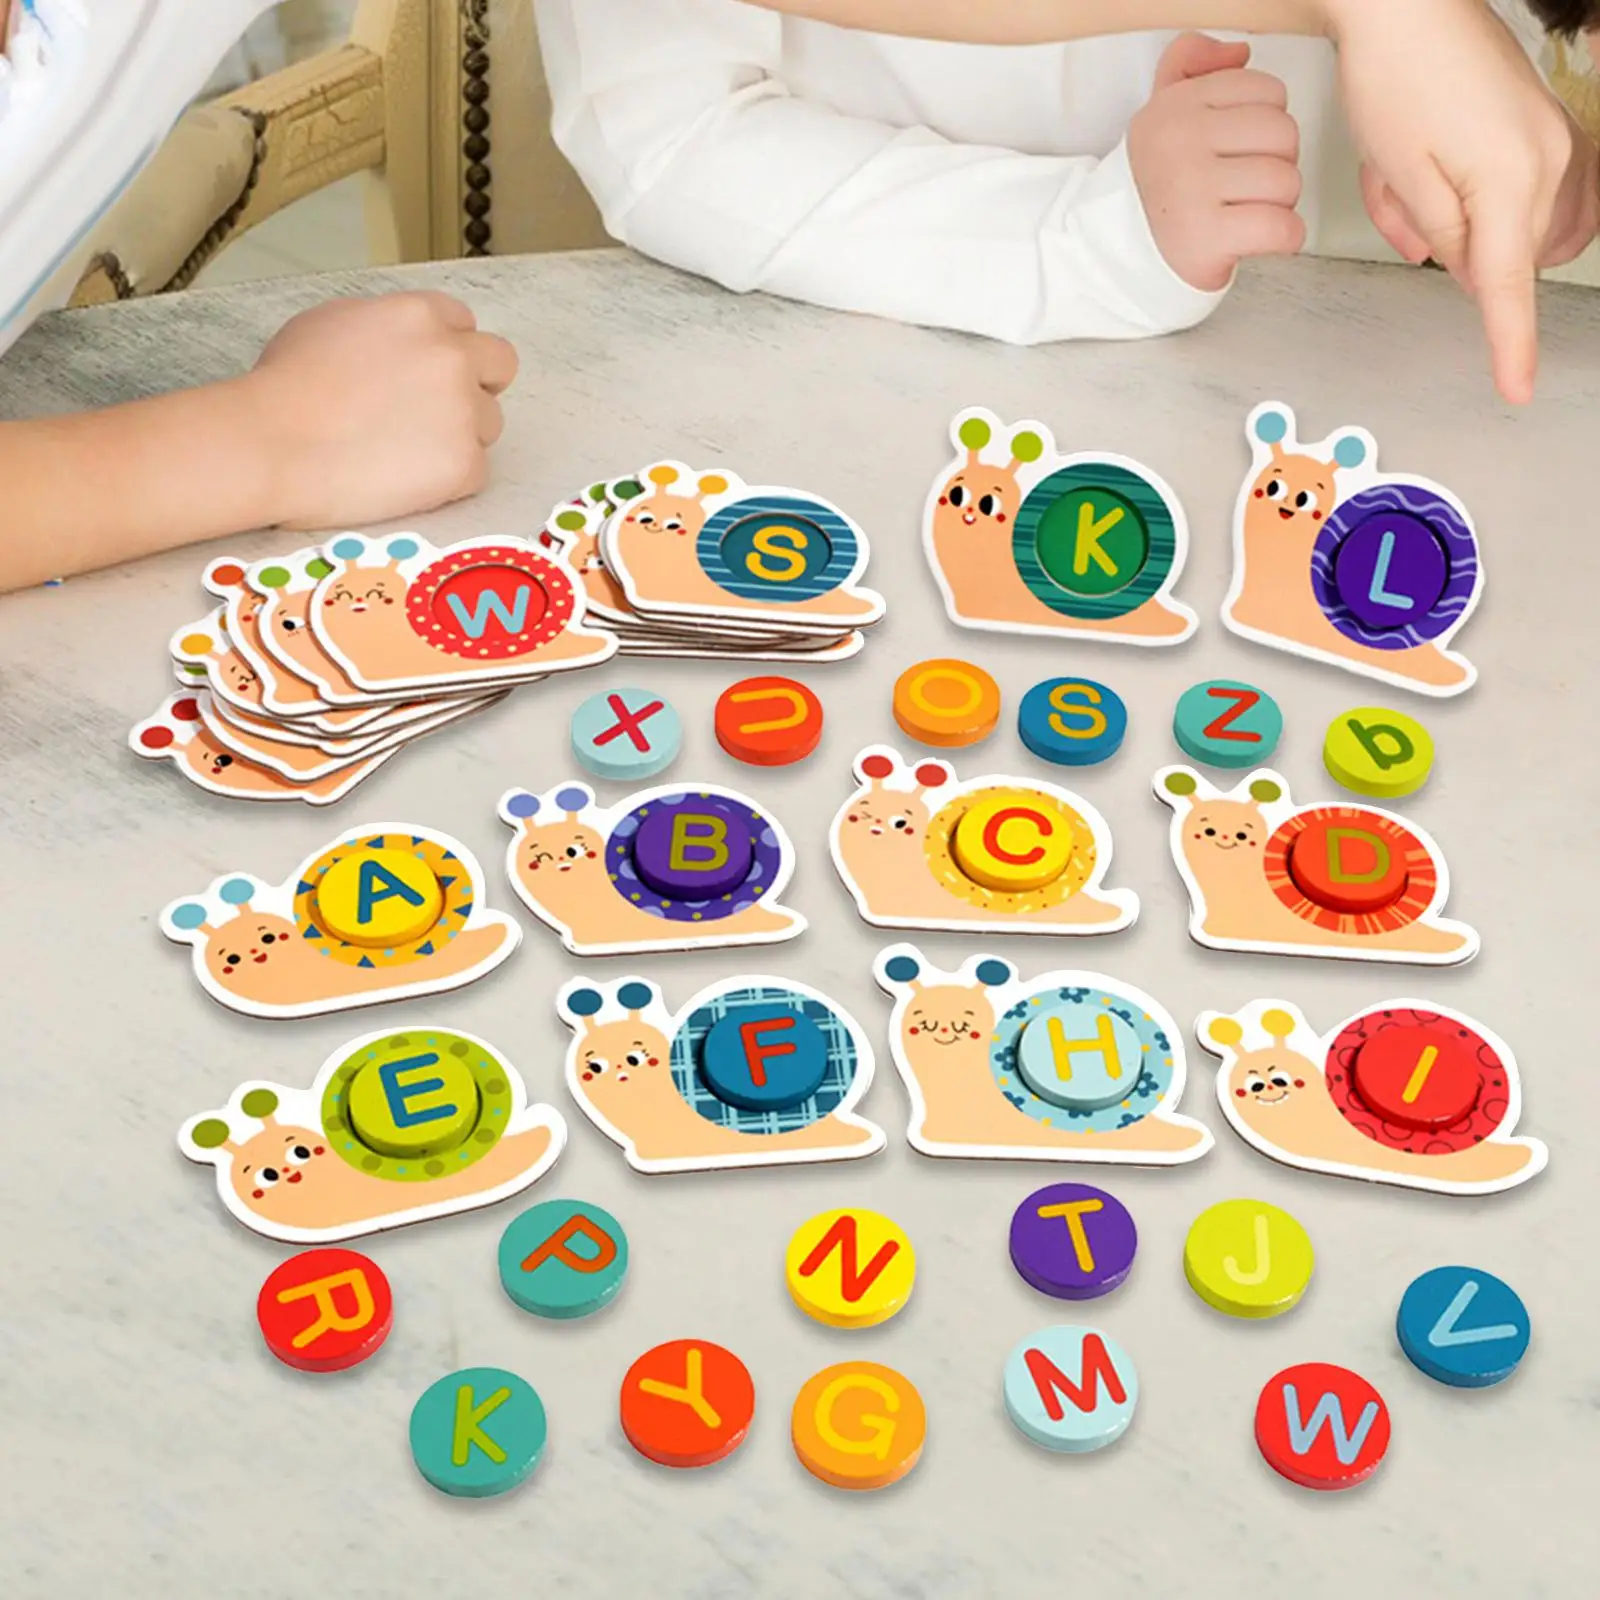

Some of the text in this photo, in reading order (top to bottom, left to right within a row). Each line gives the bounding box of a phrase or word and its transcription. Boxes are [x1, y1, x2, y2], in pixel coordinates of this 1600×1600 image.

[746, 525, 808, 582] S
[1073, 502, 1125, 577] K
[1369, 531, 1414, 610] L
[446, 585, 530, 638] W
[592, 694, 664, 753] X
[730, 688, 808, 734] U
[909, 668, 983, 718] O
[1047, 682, 1108, 740] S
[1202, 687, 1263, 743] Z
[669, 813, 730, 873] B
[983, 807, 1053, 866] C
[1326, 827, 1391, 885] D
[357, 859, 425, 924] A
[739, 1017, 796, 1086] F
[1047, 1014, 1122, 1081] H
[379, 1052, 458, 1129] E
[521, 1213, 618, 1274] P
[798, 1215, 899, 1302] N
[1037, 1198, 1104, 1273] T
[1222, 1214, 1268, 1285] J
[277, 1268, 375, 1348] R
[1428, 1281, 1517, 1348] V
[639, 1349, 721, 1429] Y
[1023, 1333, 1127, 1421] M
[451, 1385, 511, 1466] K
[814, 1373, 899, 1461] G
[1283, 1383, 1378, 1465] W
